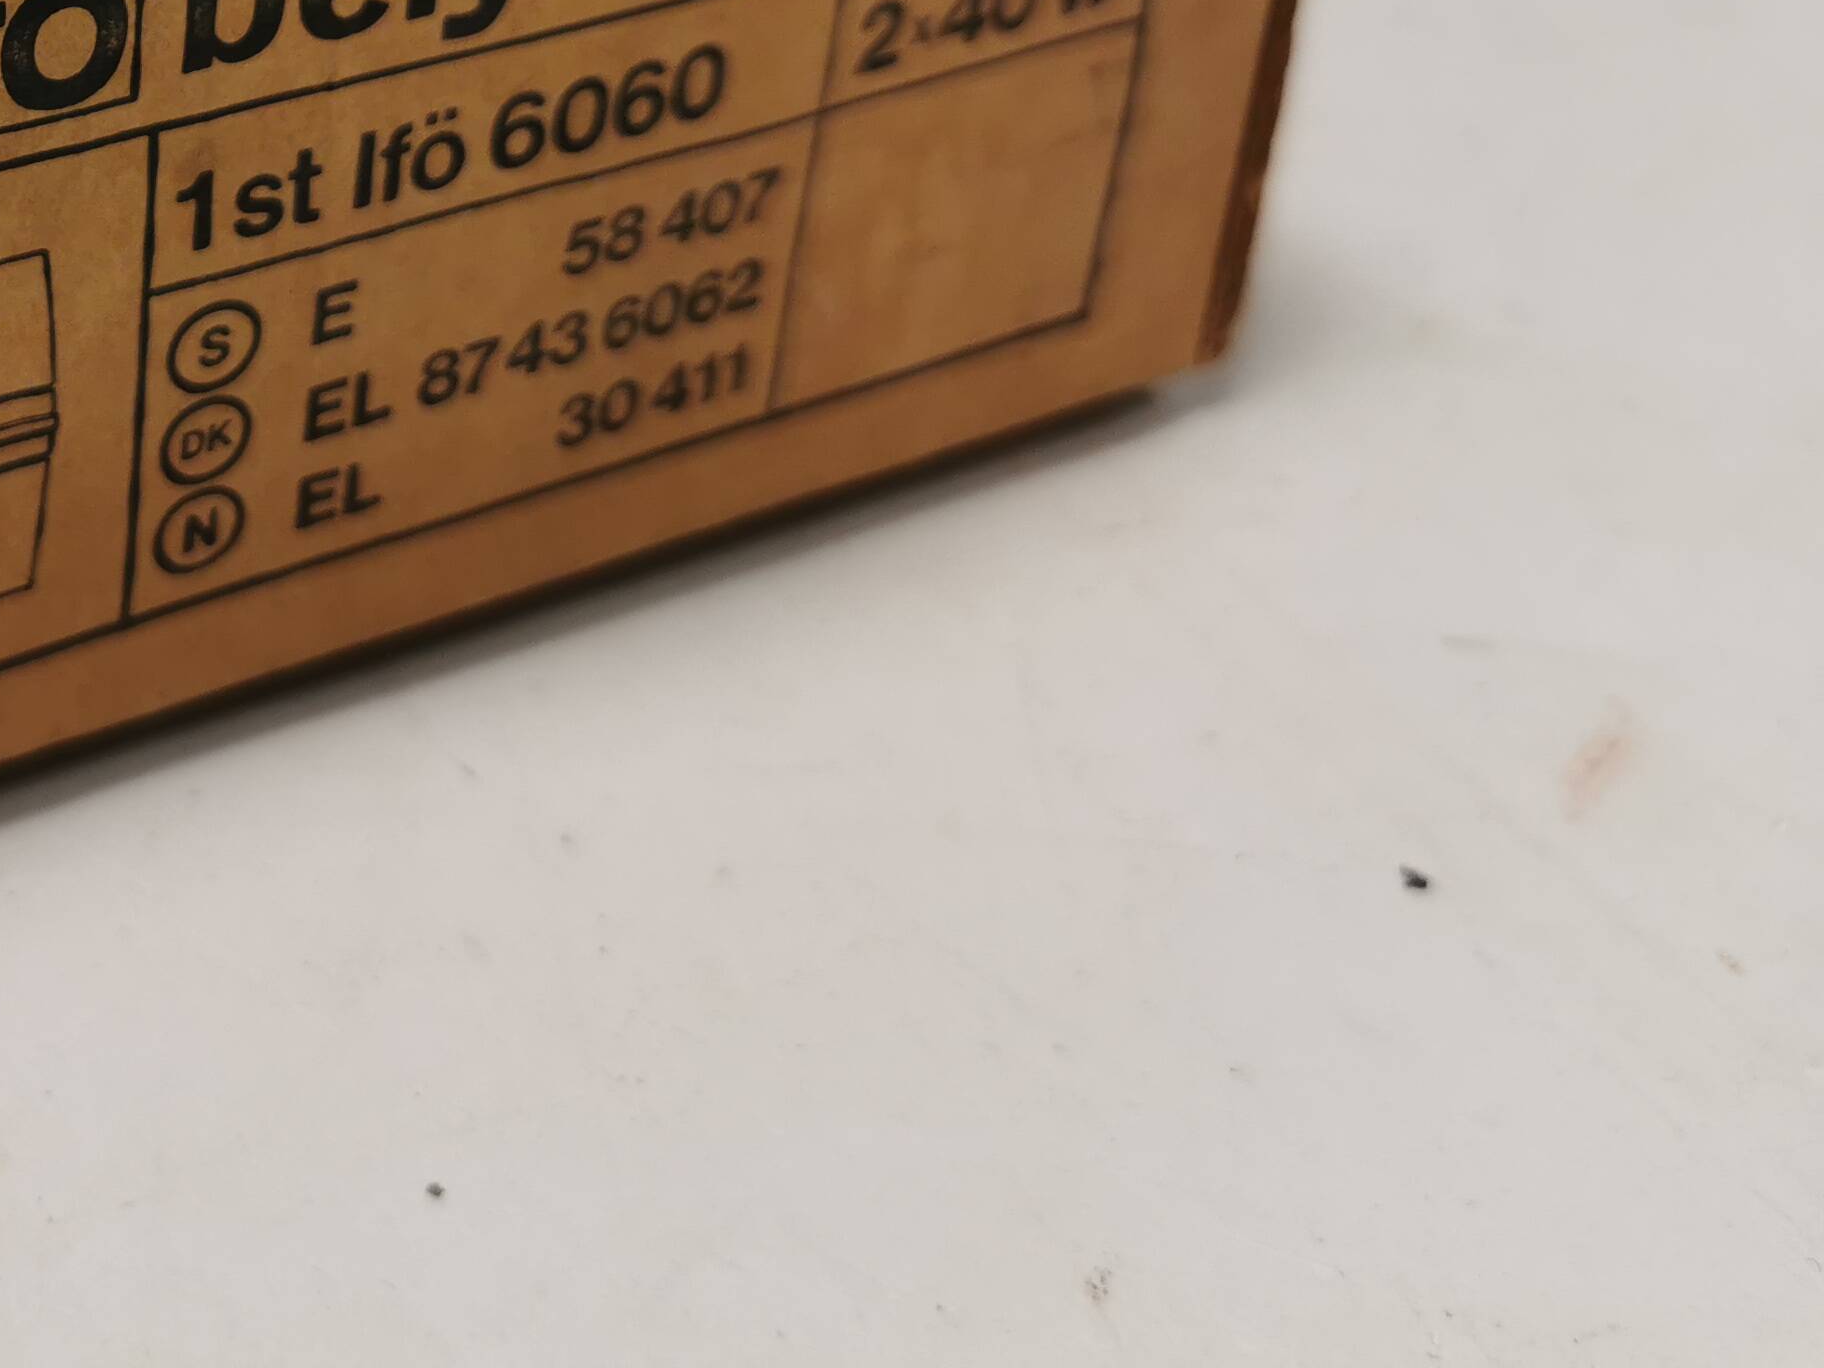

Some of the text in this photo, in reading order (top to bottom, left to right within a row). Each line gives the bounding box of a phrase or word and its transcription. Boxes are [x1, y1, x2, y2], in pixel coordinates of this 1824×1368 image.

[352, 107, 467, 210] Ifö
[489, 43, 728, 170] 6060
[198, 324, 230, 367] S
[310, 279, 359, 346] E
[179, 418, 234, 461] DK
[304, 371, 392, 442] EL
[180, 506, 221, 554] N
[294, 462, 383, 529] EL
